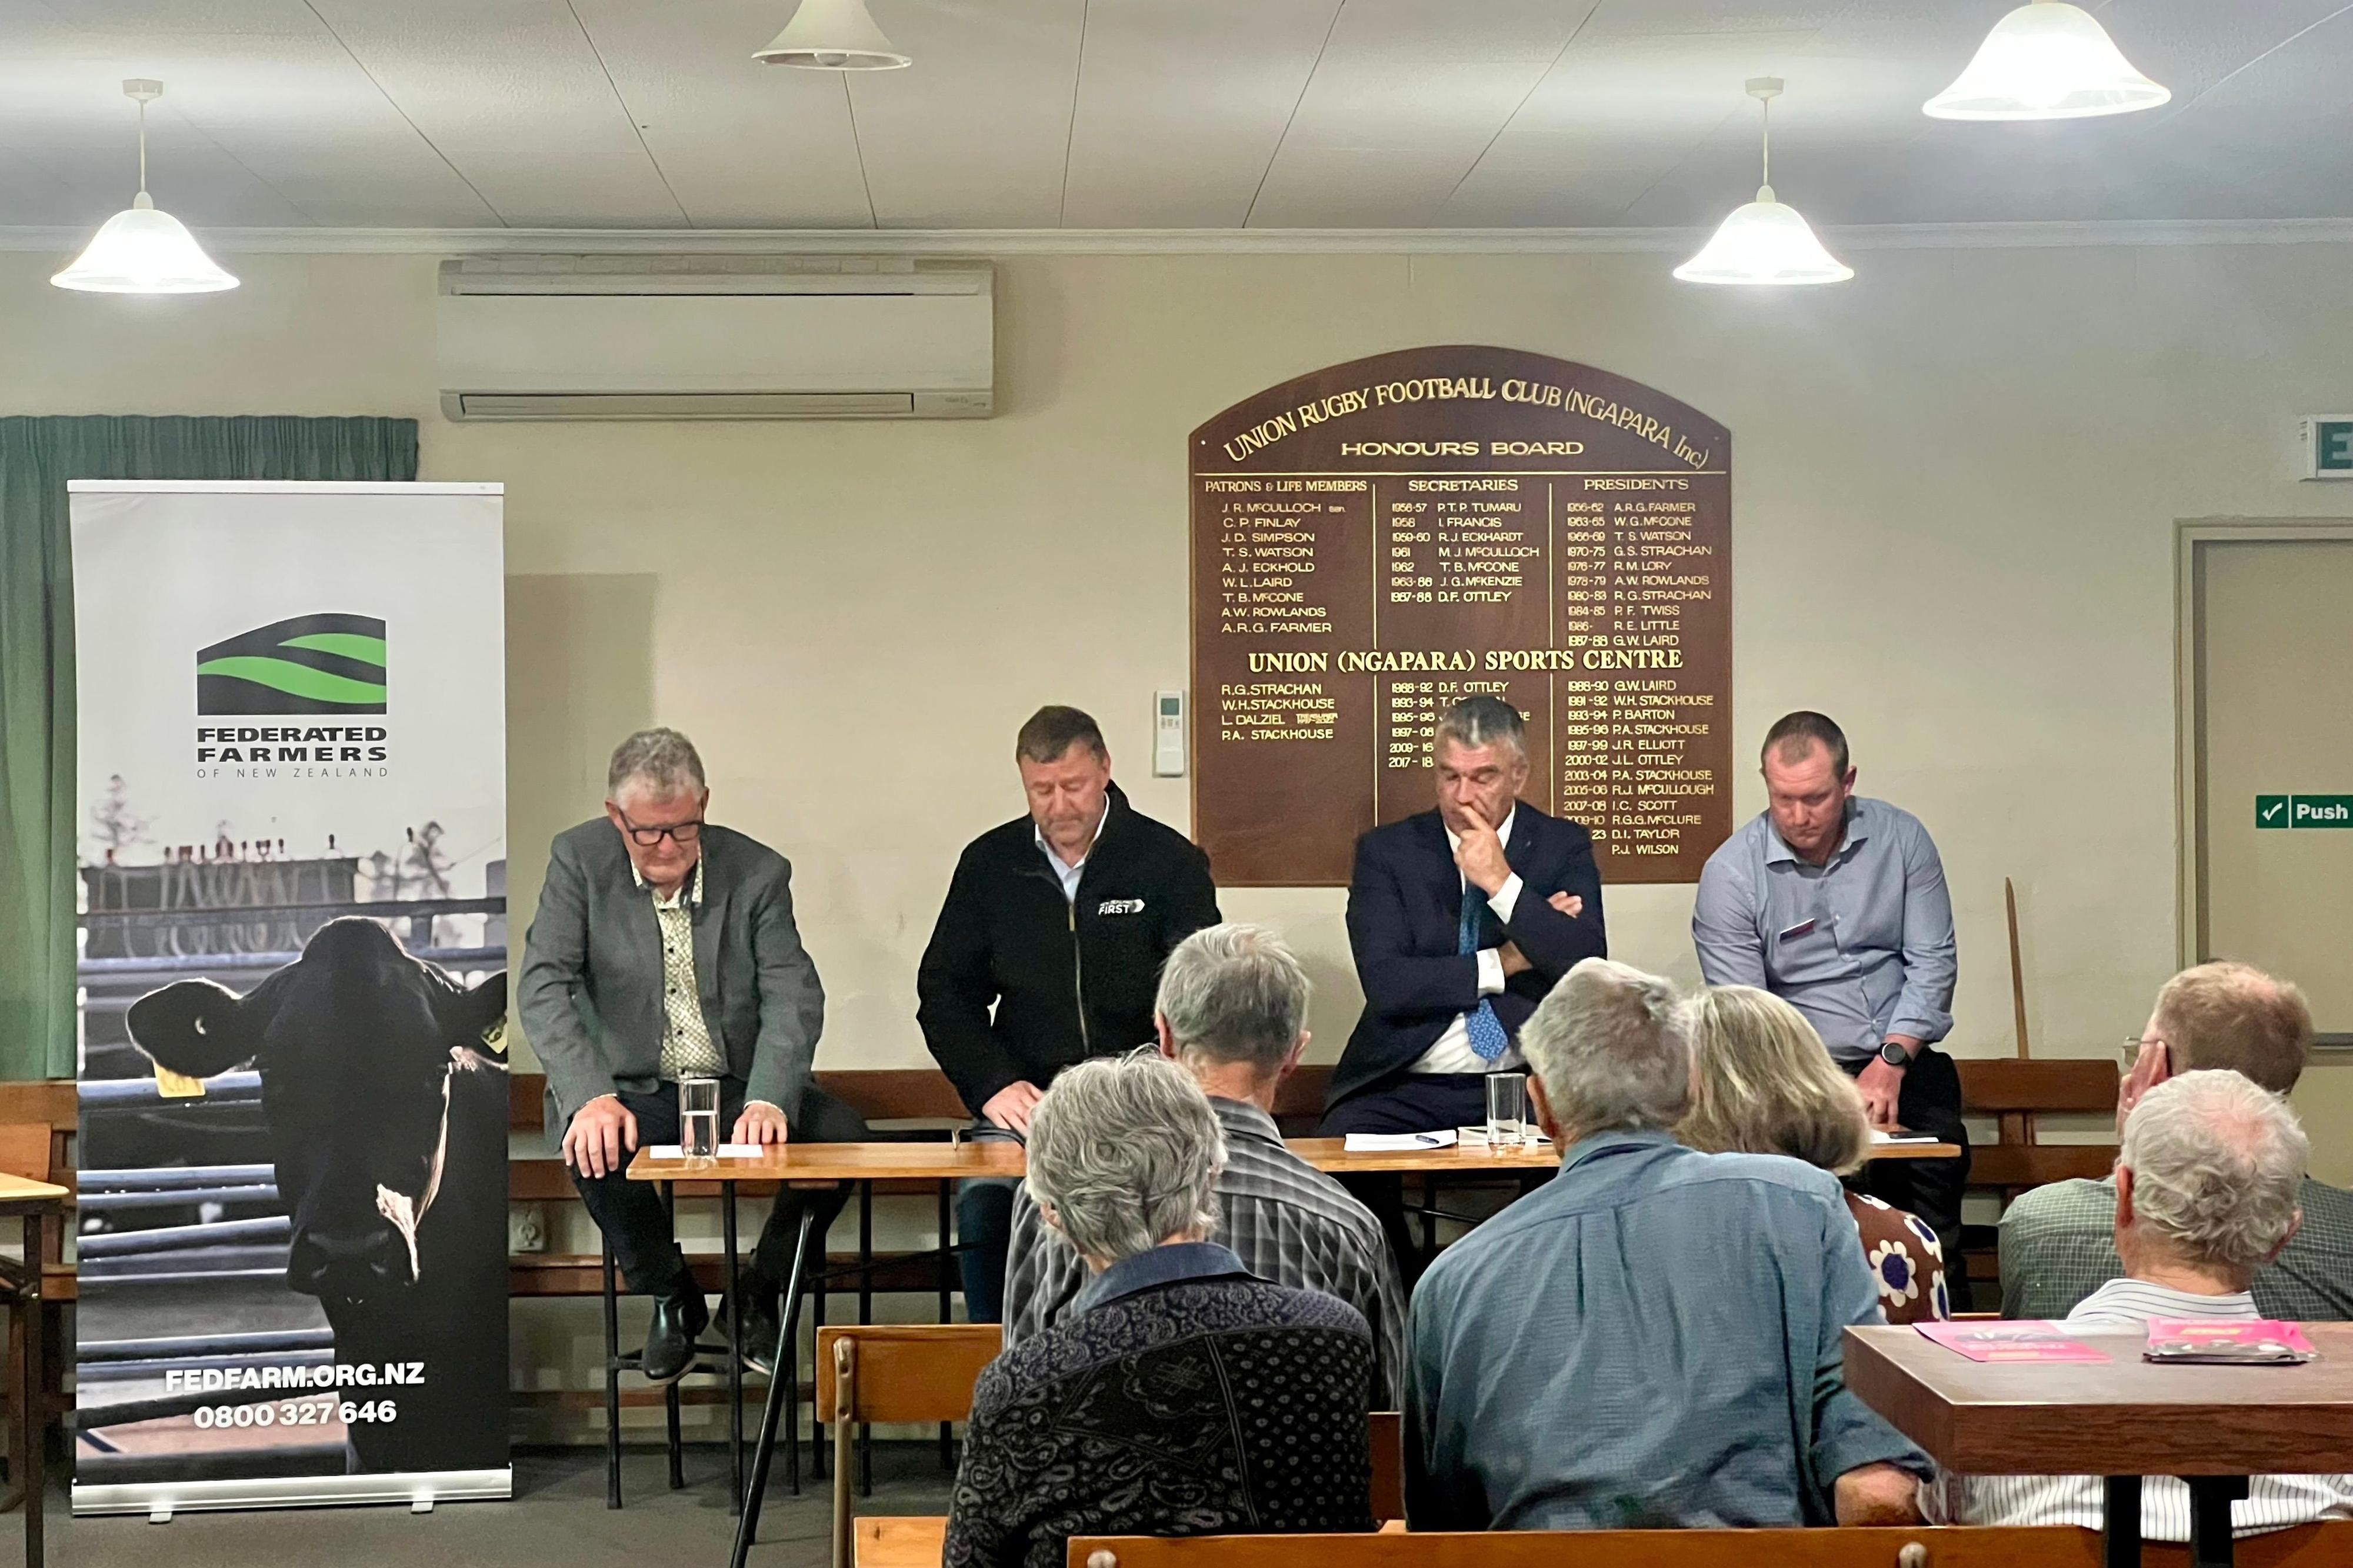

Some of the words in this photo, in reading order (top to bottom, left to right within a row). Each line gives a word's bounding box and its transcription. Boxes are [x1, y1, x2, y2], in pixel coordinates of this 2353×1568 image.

[1224, 412, 1297, 463] UNION
[1298, 388, 1369, 428] RUGBY
[1375, 378, 1497, 406] FOOTBALL
[1502, 379, 1562, 406] CLUB
[1565, 387, 1671, 449] (NGAPARA
[1342, 442, 1479, 456] HONOURS
[1491, 442, 1583, 455] BOARD
[1206, 481, 1261, 492] PATRONS
[1277, 481, 1302, 491] LIFE
[1306, 481, 1367, 491] MEMBERS
[1409, 479, 1518, 491] SECRETARIES
[1584, 479, 1688, 490] PRESIDENTS
[1247, 503, 1321, 512] McCULLOCH
[1392, 503, 1427, 512] 1956-57
[1472, 503, 1521, 512] TUMARU
[1568, 503, 1604, 512] 1956-62
[1649, 503, 1695, 512] FARMER
[1255, 518, 1301, 527] FINLAY
[1392, 518, 1415, 527] 1958
[1447, 518, 1502, 527] FRANCIS
[1568, 517, 1605, 526] 1963-65
[1252, 533, 1314, 542] SIMPSON
[1393, 532, 1430, 542] 1959-60
[1462, 532, 1524, 542] ECKHARDT
[1640, 531, 1691, 541] WATSON
[1255, 548, 1313, 557] WATSON
[1392, 548, 1410, 557] 1961
[1466, 547, 1539, 557] McCULLOCH
[1568, 546, 1605, 556] 1970-75
[1641, 546, 1711, 556] STRACHAN
[1254, 563, 1314, 572] ECKHOLD
[1392, 562, 1414, 572] 1962
[1568, 562, 1605, 571] 1976-77
[1642, 562, 1672, 571] LORY
[1568, 576, 1606, 586] 1978-79
[1642, 576, 1709, 585] ROWLANDS
[1391, 592, 1432, 602] 1987-88
[1464, 592, 1512, 602] OTTLEY
[1568, 590, 1607, 600] 1980-83
[1642, 590, 1711, 600] STRACHAN
[1253, 608, 1326, 616] ROWLANDS
[1568, 606, 1605, 616] 1984-85
[1641, 605, 1679, 615] TWISS
[1271, 623, 1331, 632] FARMER
[1641, 620, 1679, 630] LITTLE
[1568, 635, 1608, 646] 1987-88
[1644, 635, 1679, 646] LAIRD
[1249, 653, 1328, 672] UNION
[1338, 649, 1476, 672] (NGAPARA)
[1485, 650, 1574, 670] SPORTS
[1582, 648, 1684, 670] CENTRE
[1392, 682, 1432, 693] 1988-92
[1464, 682, 1509, 692] OTTLEY
[1568, 681, 1609, 692] 1988-90
[1642, 680, 1676, 691] LAIRD
[1392, 698, 1434, 708] 1993-94
[1639, 695, 1713, 706] STACKHOUSE
[1392, 712, 1435, 722] 1995-96
[1568, 710, 1608, 720] 1993-94
[1625, 709, 1674, 719] BARTON
[1236, 715, 1285, 725] DALZIEL
[197, 727, 386, 742] FEDERATED
[1251, 729, 1333, 739] STACKHOUSE
[1568, 725, 1609, 735] 1995-96
[1635, 725, 1708, 735] STACKHOUSE
[1568, 740, 1608, 750] 1997-99
[1639, 740, 1685, 749] ELLIOTT
[197, 748, 386, 762] FARMERS
[1565, 755, 1608, 766] 2000-02
[1638, 755, 1683, 765] OTTLEY
[197, 768, 219, 778] OF
[237, 768, 276, 778] NEW
[294, 768, 387, 778] ZEALAND
[1565, 770, 1607, 781] 2003-04
[1636, 770, 1712, 780] STACKHOUSE
[1564, 785, 1608, 795] 2005-06
[1638, 785, 1714, 795] McCULLOUGH
[1564, 800, 1606, 811] 2007-08
[1638, 800, 1677, 811] SCOTT
[2297, 803, 2348, 819] Push
[1634, 829, 1679, 838] TAYLOR
[1637, 845, 1678, 854] WILSON
[1098, 904, 1129, 915] FIRST
[165, 1362, 425, 1392] FEDFARM.ORG.NZ
[194, 1406, 275, 1429] 0800
[279, 1402, 334, 1426] 327
[338, 1400, 397, 1424] 646
